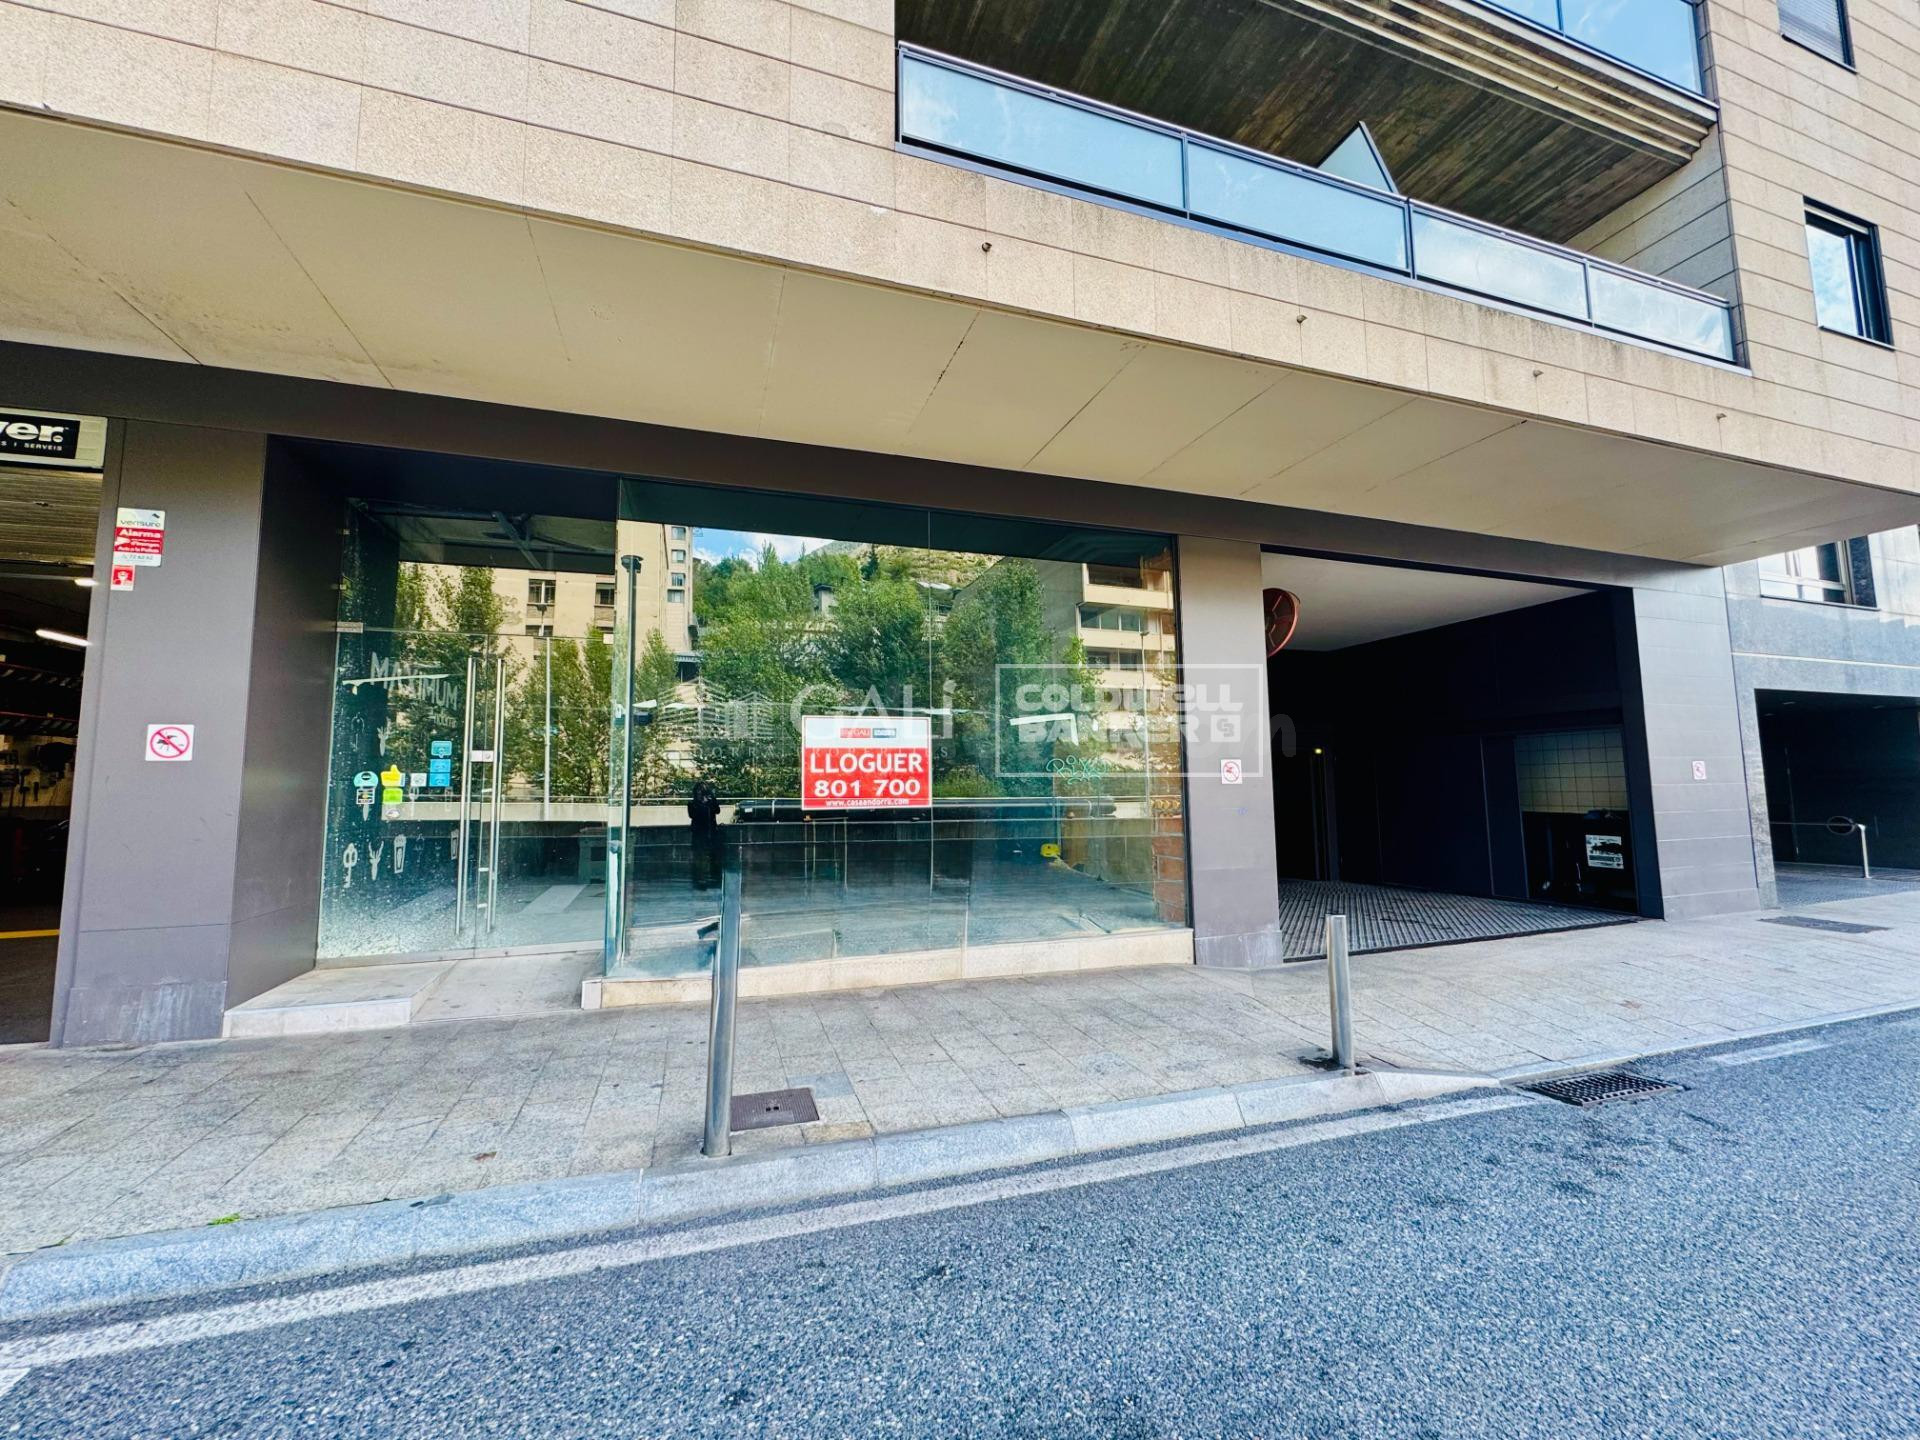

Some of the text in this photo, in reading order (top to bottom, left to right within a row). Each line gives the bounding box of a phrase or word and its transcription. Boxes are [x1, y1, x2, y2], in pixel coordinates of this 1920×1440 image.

[24, 442, 63, 451] SERVEIS
[810, 752, 924, 774] LLOGUER
[814, 778, 921, 798] 801 700
[826, 798, 909, 807] www.casaandorra.com
